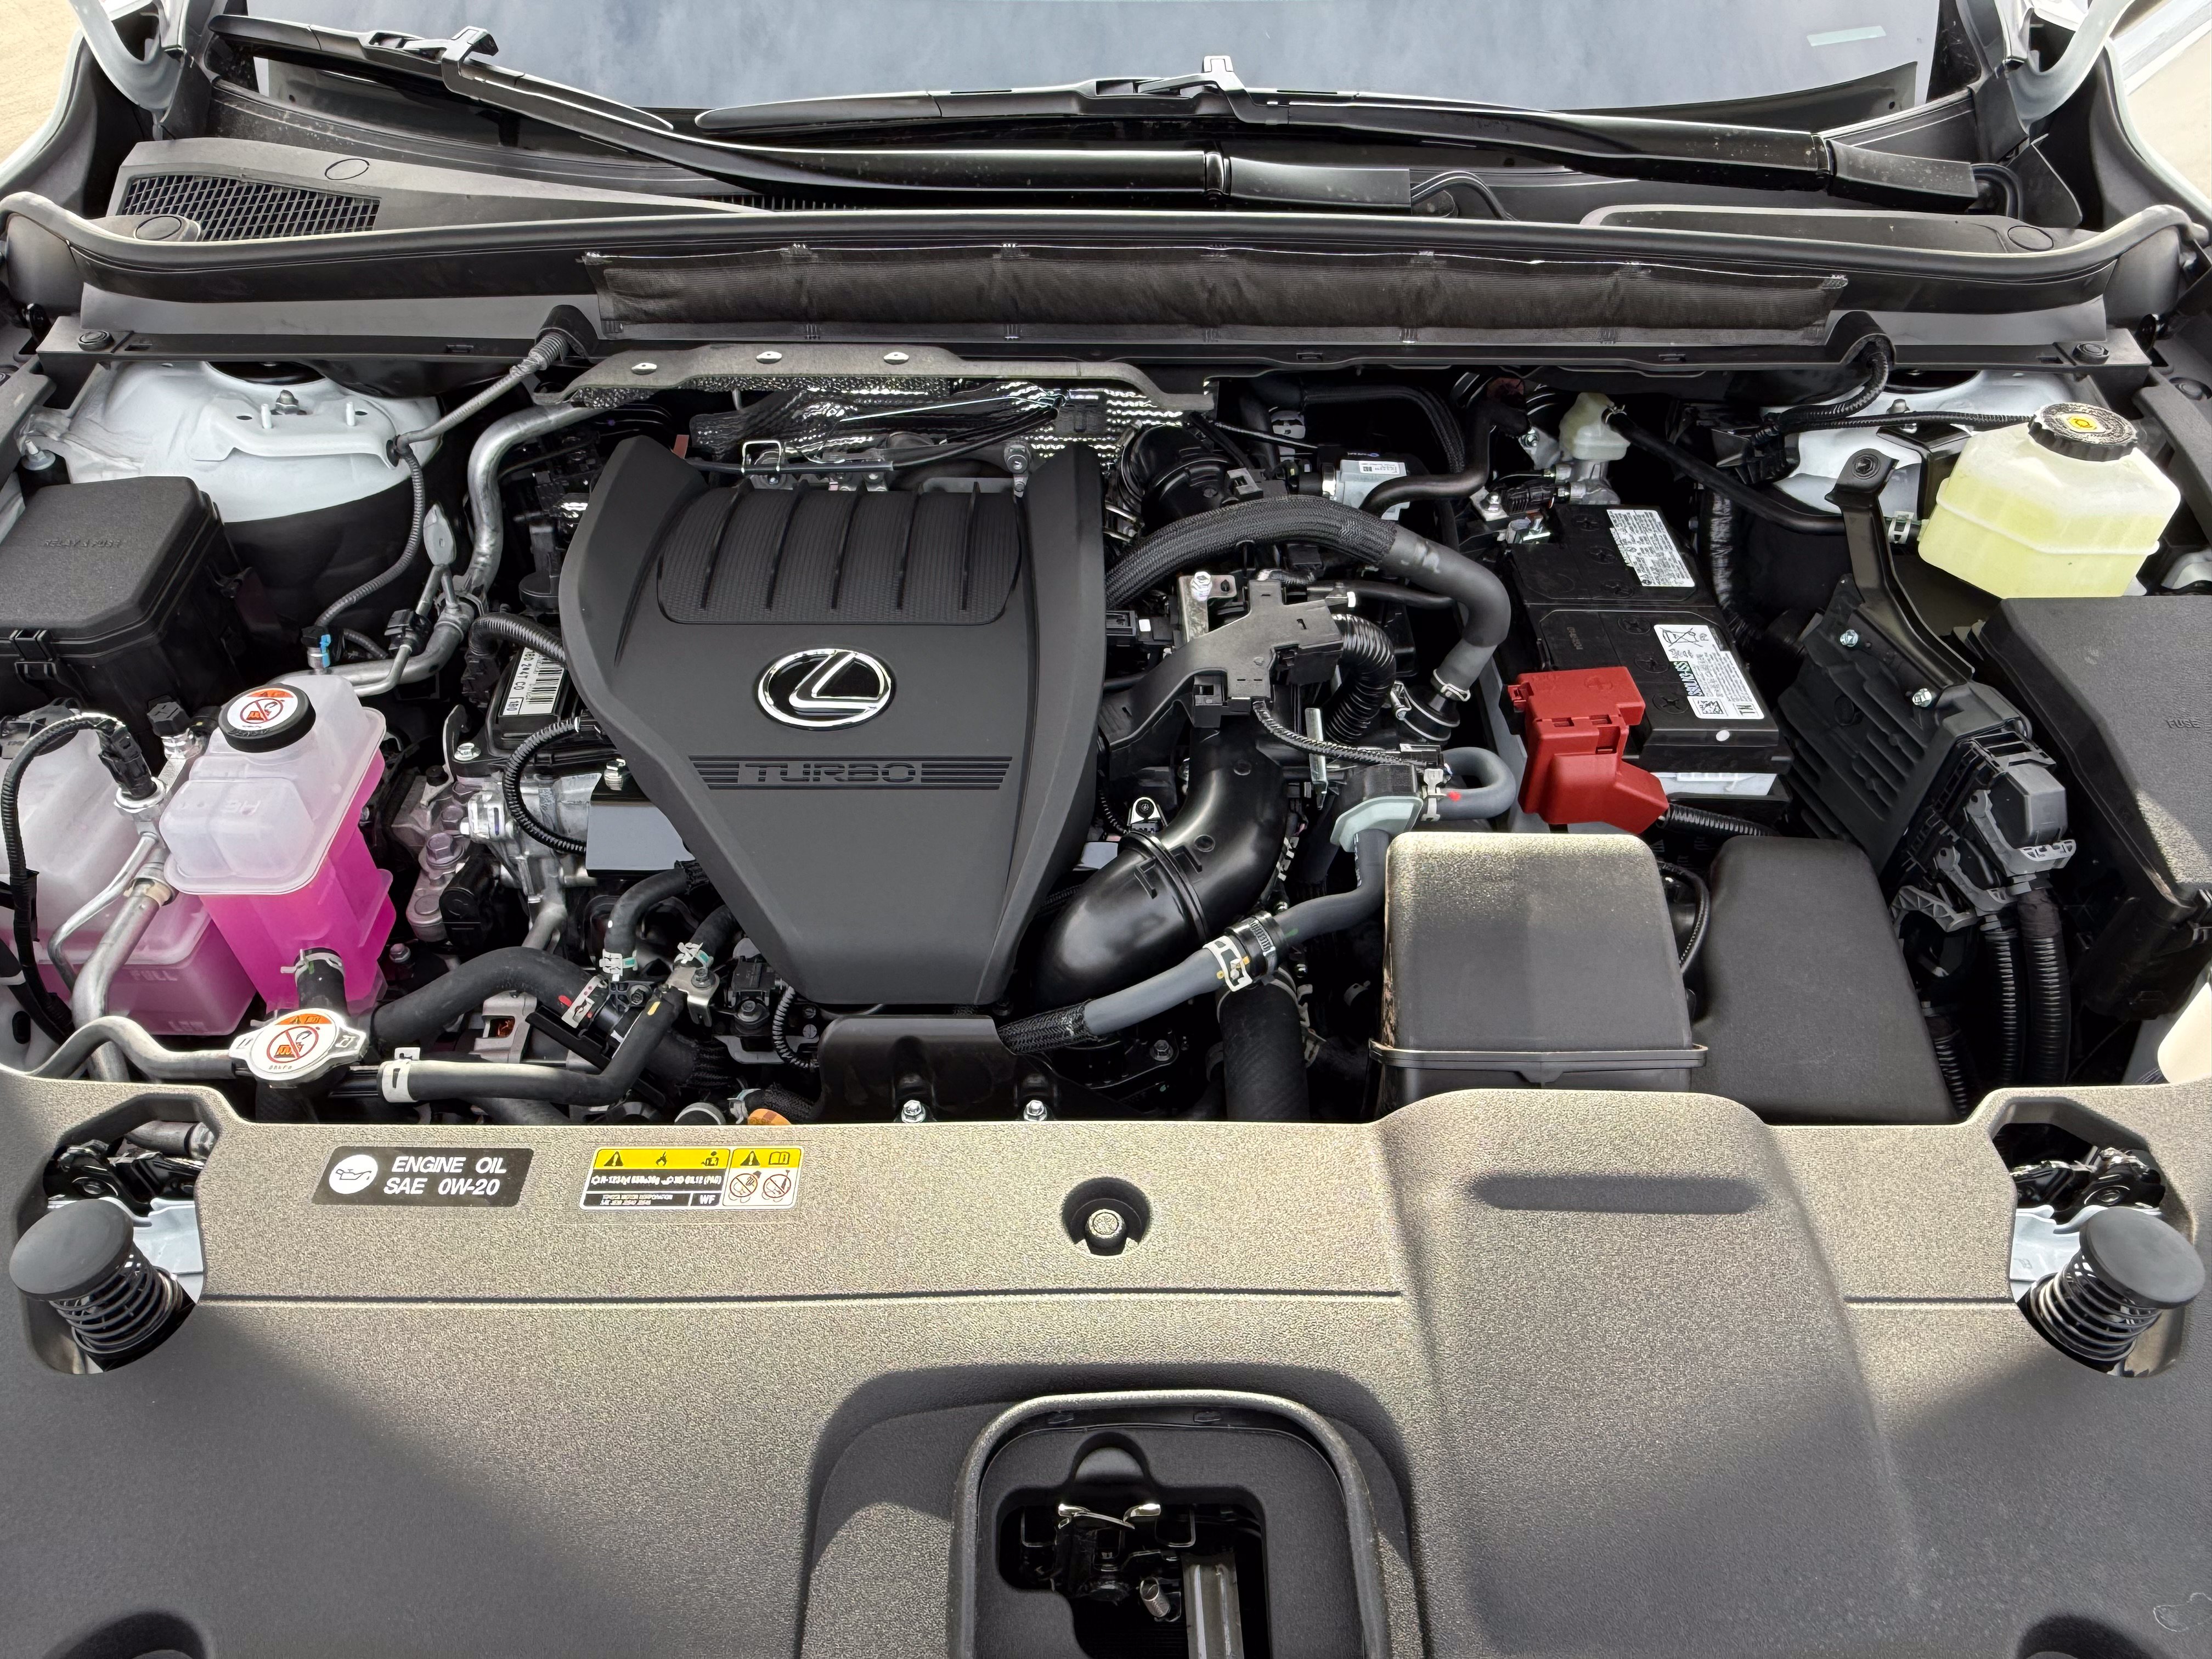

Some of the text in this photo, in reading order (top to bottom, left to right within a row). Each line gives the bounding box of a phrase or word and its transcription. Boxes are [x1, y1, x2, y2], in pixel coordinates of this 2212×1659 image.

[745, 763, 916, 782] TURBO
[391, 1156, 507, 1174] ENGINE OIL
[383, 1177, 500, 1195] SAE 0W-20
[699, 1194, 716, 1205] WF
